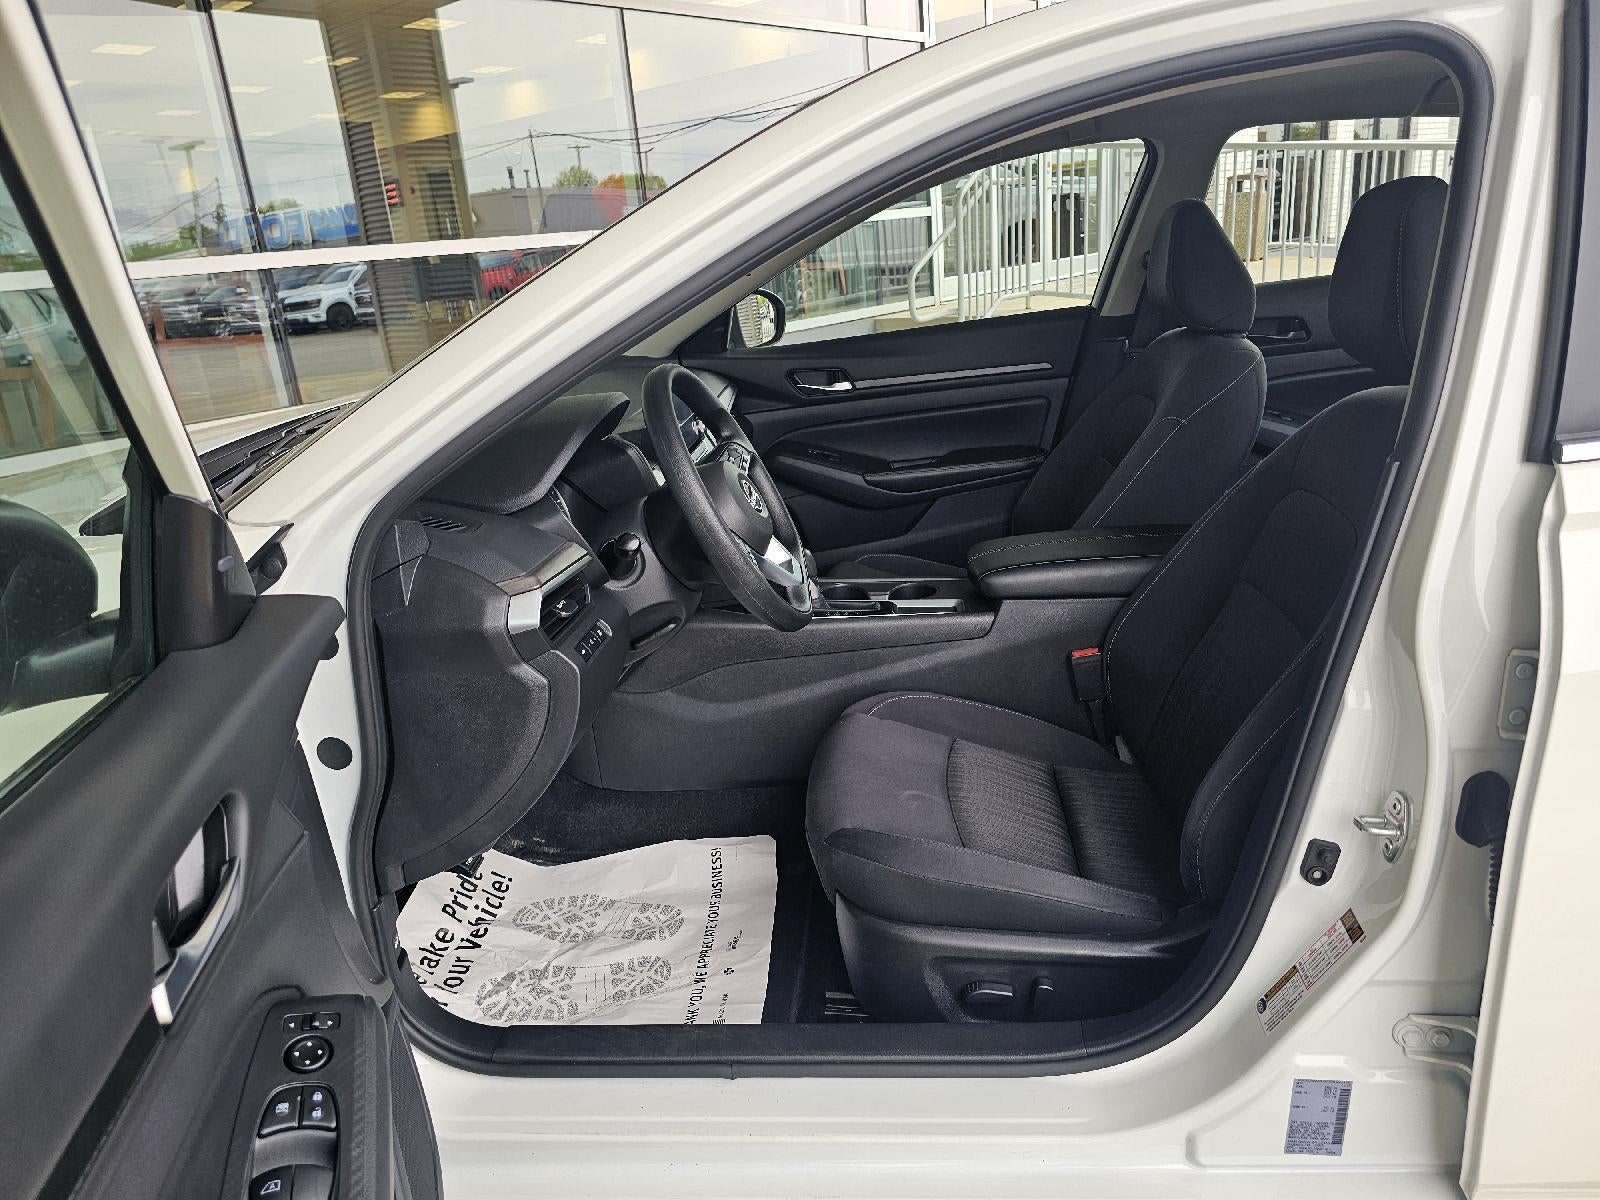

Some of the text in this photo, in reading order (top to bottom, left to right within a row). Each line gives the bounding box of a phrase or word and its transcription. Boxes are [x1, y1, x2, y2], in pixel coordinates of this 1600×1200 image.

[454, 870, 513, 950] Vehicle!
[697, 924, 718, 969] APPRECIATE
[711, 846, 723, 900] BUSINESS!
